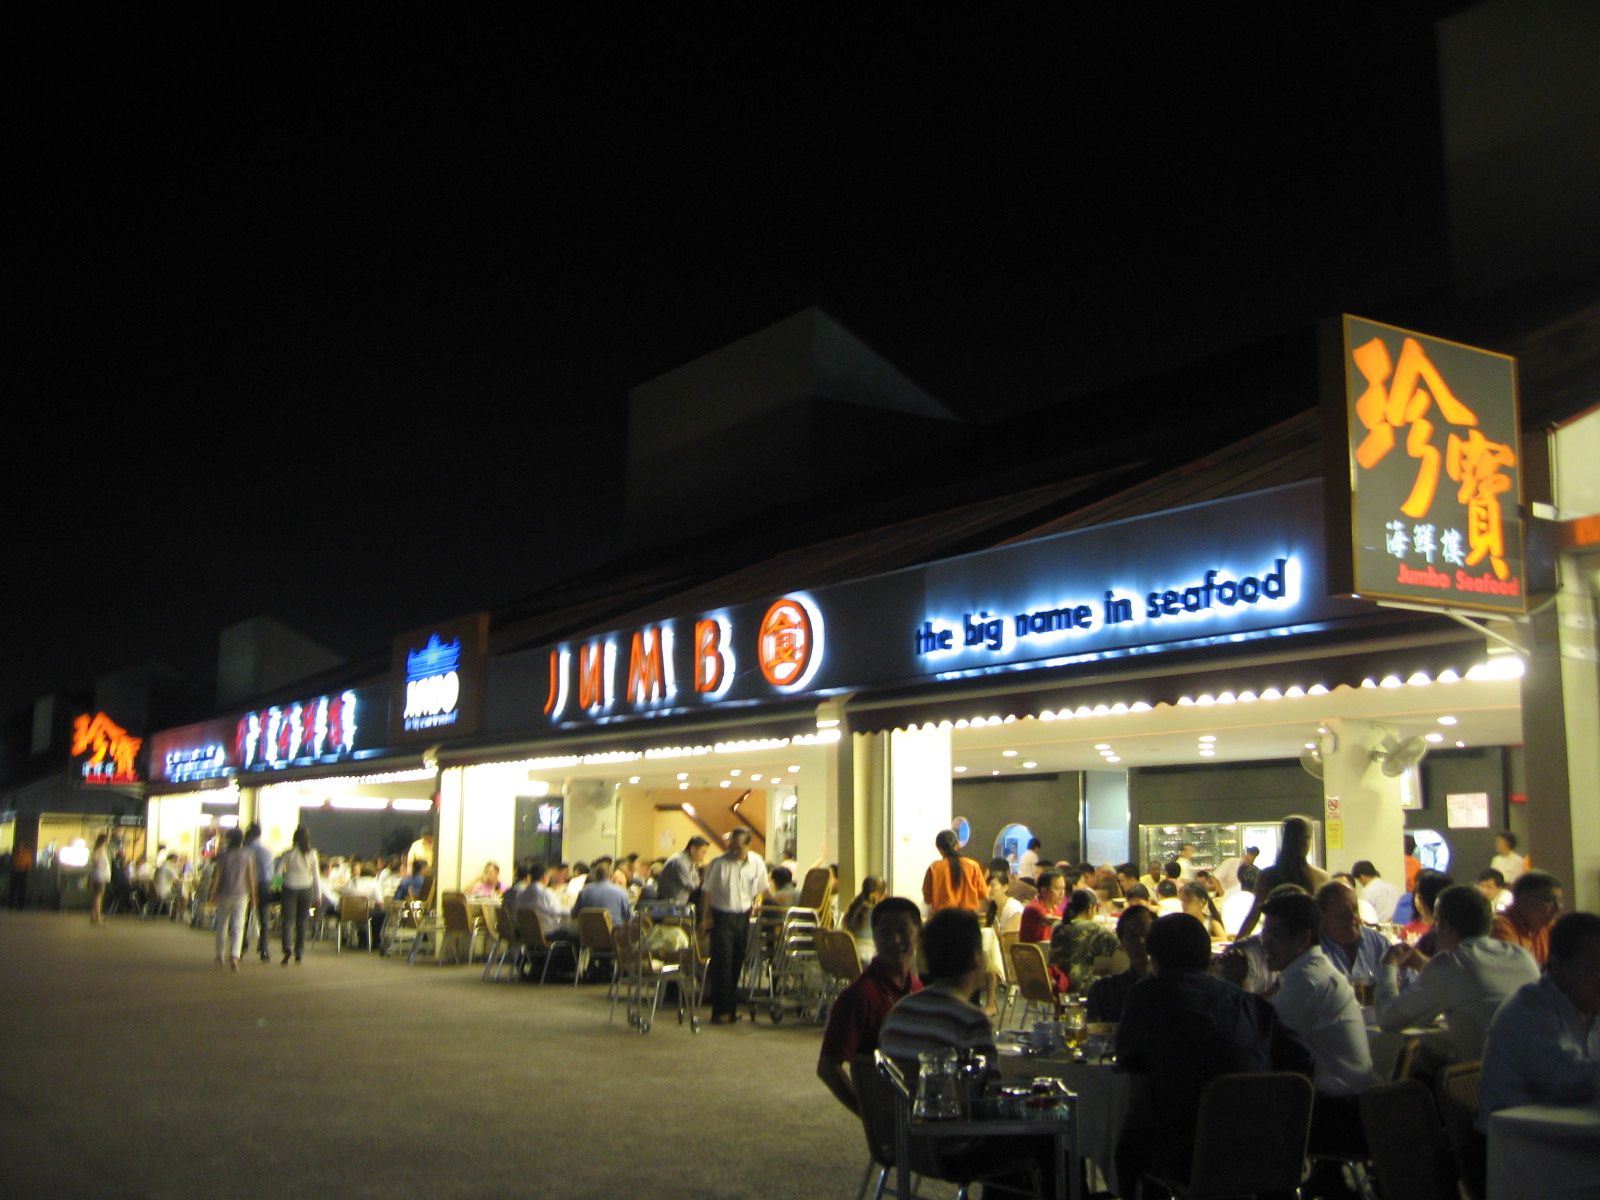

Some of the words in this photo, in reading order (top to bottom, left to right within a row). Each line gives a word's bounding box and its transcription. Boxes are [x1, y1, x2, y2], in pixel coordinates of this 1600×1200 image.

[1351, 336, 1517, 580] 珍寶
[914, 621, 953, 655] the
[963, 612, 1004, 652] big
[1015, 605, 1092, 637] name
[1104, 590, 1134, 625] in
[1146, 558, 1288, 619] seafood
[1396, 562, 1452, 589] Jumbo
[1455, 569, 1521, 597] Seafood
